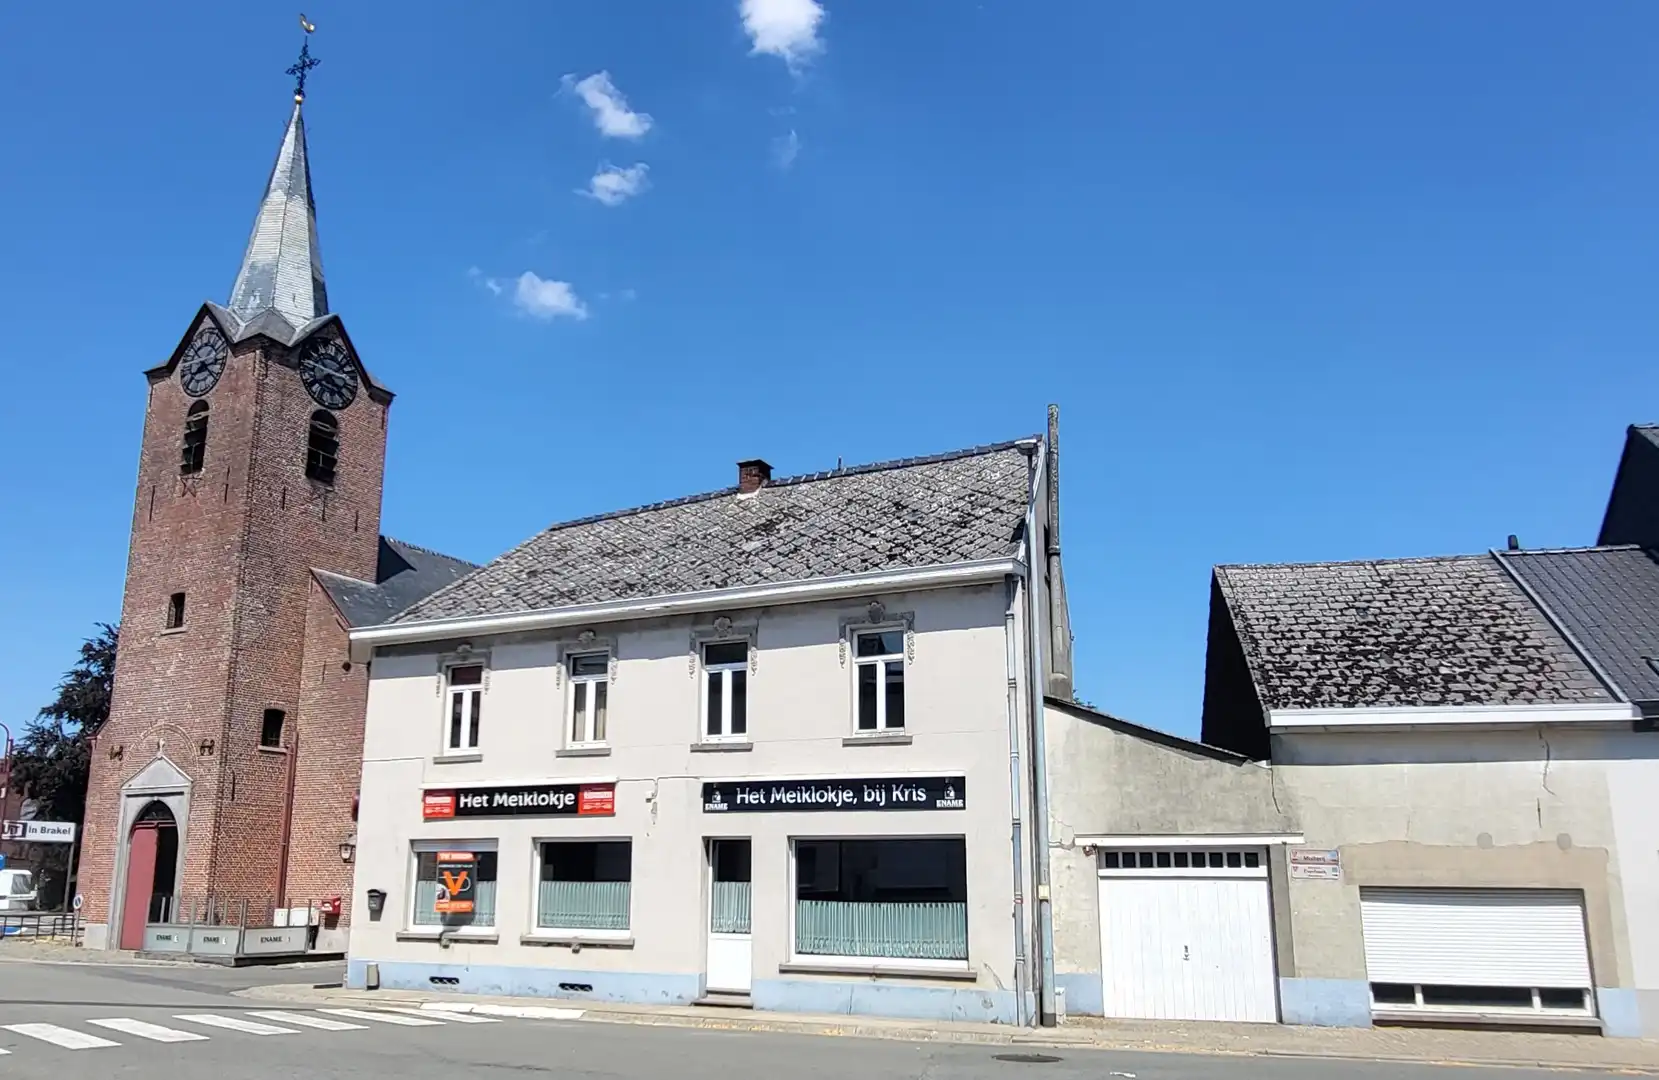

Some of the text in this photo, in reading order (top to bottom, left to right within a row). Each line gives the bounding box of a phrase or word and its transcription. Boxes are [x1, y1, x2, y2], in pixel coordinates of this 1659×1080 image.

[459, 793, 489, 808] Het
[492, 790, 576, 809] Meiklokje
[736, 783, 927, 807] Het Meiklokje, bij Kris
[704, 802, 728, 810] ENAME
[936, 799, 964, 808] ENAME
[40, 826, 71, 835] Brakel
[260, 935, 283, 944] ENAME
